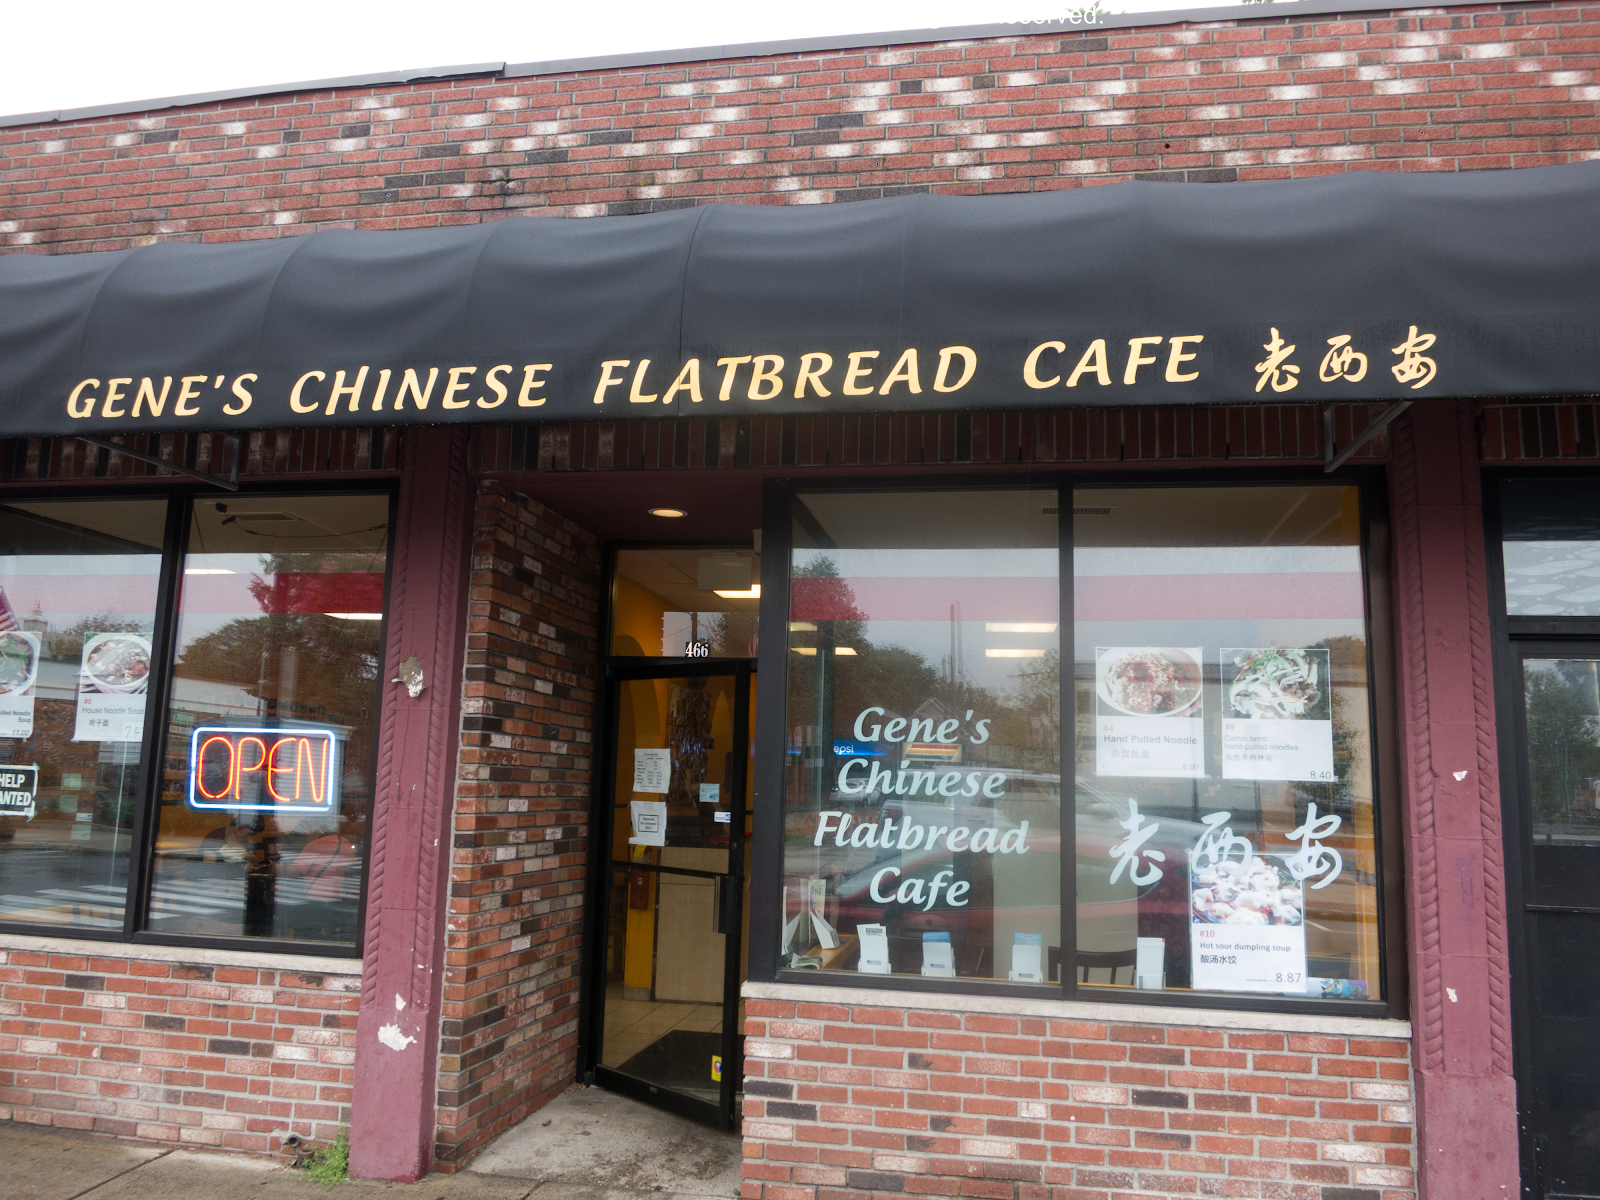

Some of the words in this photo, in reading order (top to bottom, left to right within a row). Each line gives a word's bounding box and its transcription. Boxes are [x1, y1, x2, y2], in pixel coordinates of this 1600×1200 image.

[66, 372, 258, 419] GENE'S
[289, 363, 553, 416] CHINESE
[593, 345, 978, 405] FLATBREAD
[1023, 334, 1204, 390] CAFE
[685, 641, 709, 658] 466
[82, 706, 103, 714] House
[103, 707, 126, 715] Noodle
[127, 707, 145, 716] Soup
[853, 706, 991, 745] Gene's
[1102, 724, 1114, 733] #4
[1103, 735, 1128, 743] Hand
[1131, 735, 1161, 744] Pulled
[1163, 736, 1198, 745] Noodle
[1223, 734, 1248, 742] Cumin
[833, 744, 854, 755] epsi
[1223, 743, 1268, 751] hand-pulled
[1269, 743, 1299, 751] noodles
[196, 735, 329, 803] OPEN
[0, 773, 26, 788] HELP
[837, 757, 1007, 799] Chinese
[1309, 770, 1332, 780] 8.40
[0, 790, 32, 806] ANTED
[813, 810, 1030, 855] Flatbread
[869, 865, 970, 912] Cafe
[1199, 929, 1216, 938] #10
[1234, 943, 1271, 952] dumpling
[1272, 945, 1291, 953] soup
[1200, 954, 1237, 964] 酸汤水饺
[1275, 972, 1302, 983] 8.87
